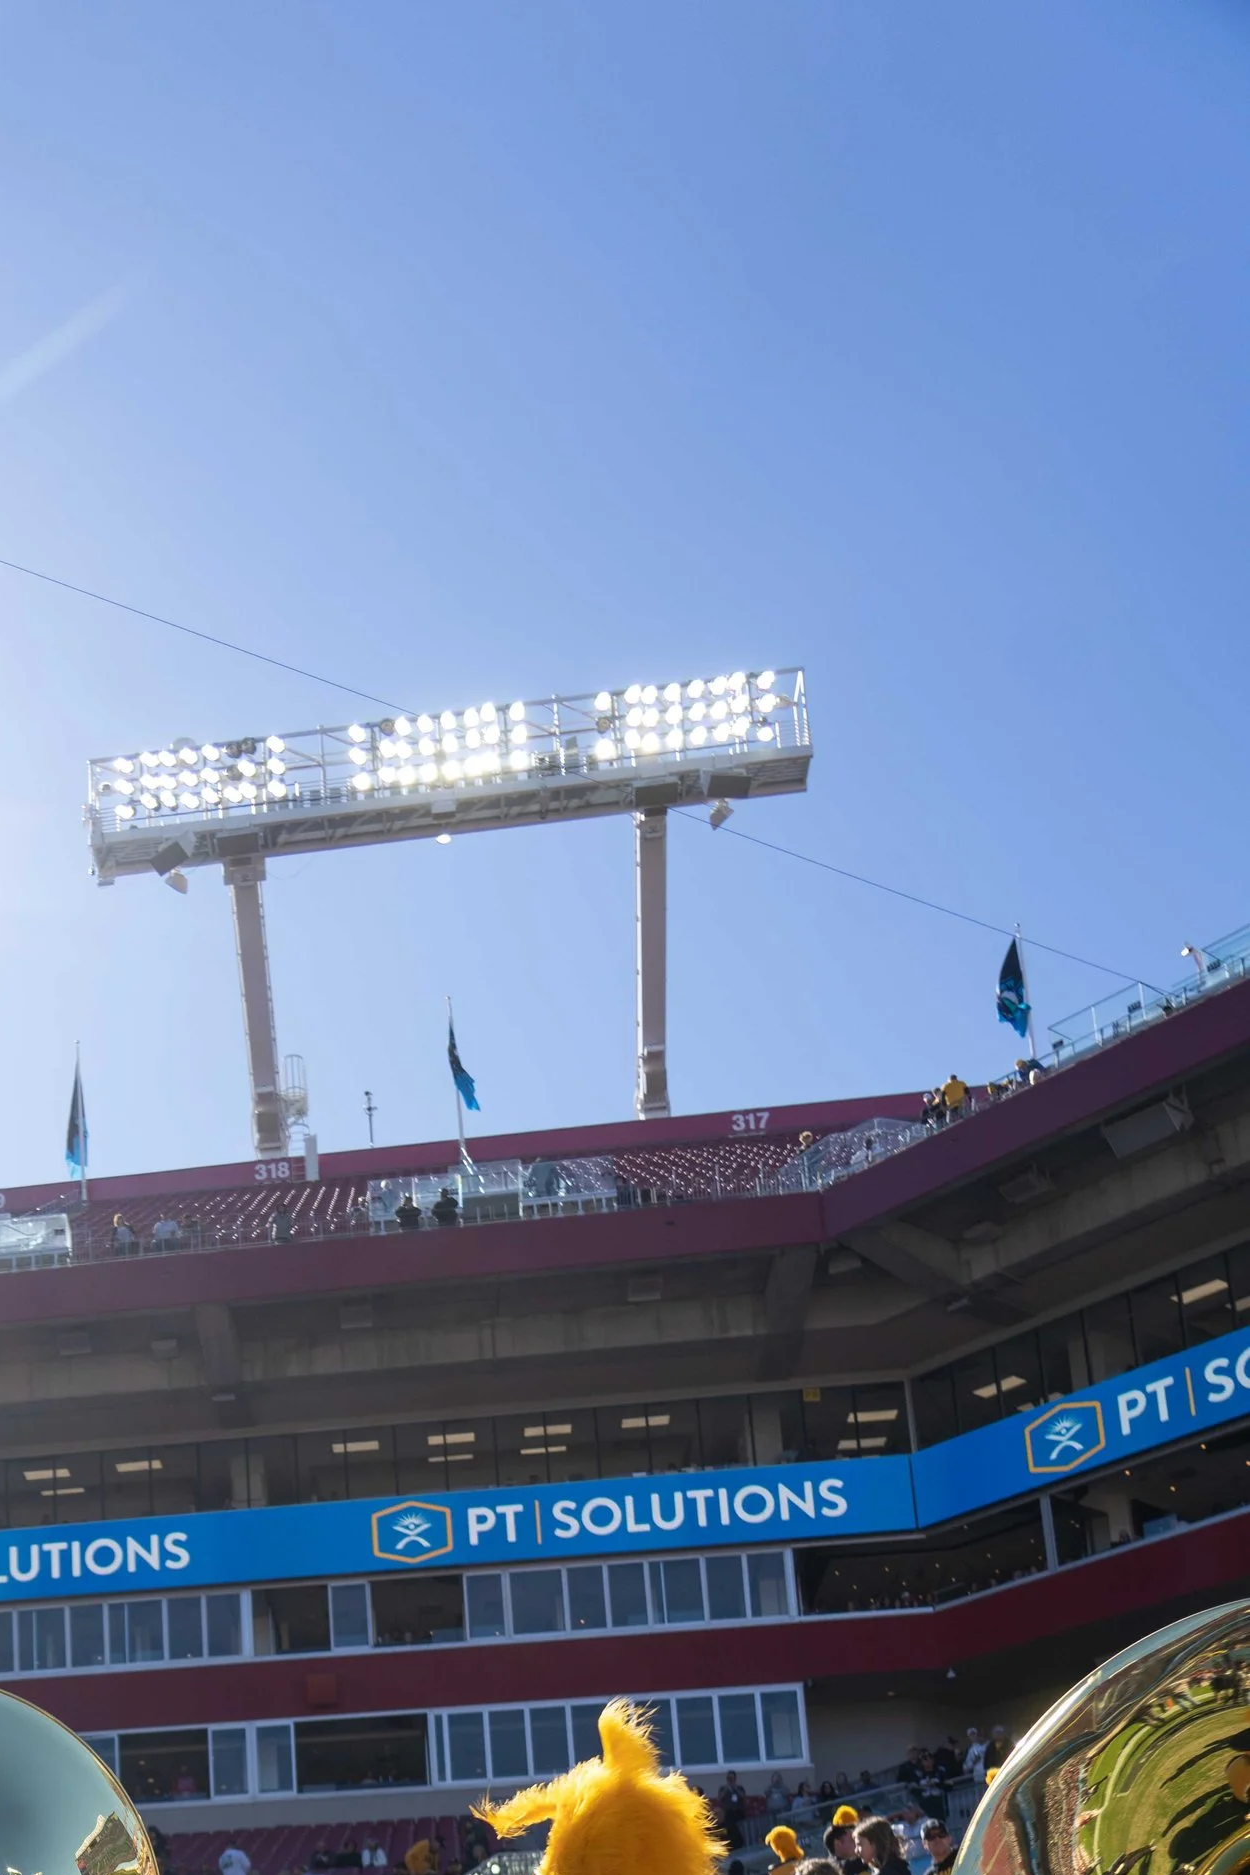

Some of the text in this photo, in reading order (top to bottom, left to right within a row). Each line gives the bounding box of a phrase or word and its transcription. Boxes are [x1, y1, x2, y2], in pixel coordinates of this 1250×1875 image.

[731, 1111, 770, 1131] 317
[254, 1162, 291, 1181] 318
[1116, 1375, 1175, 1437] PT
[466, 1478, 849, 1546] PT SOLUTIONS
